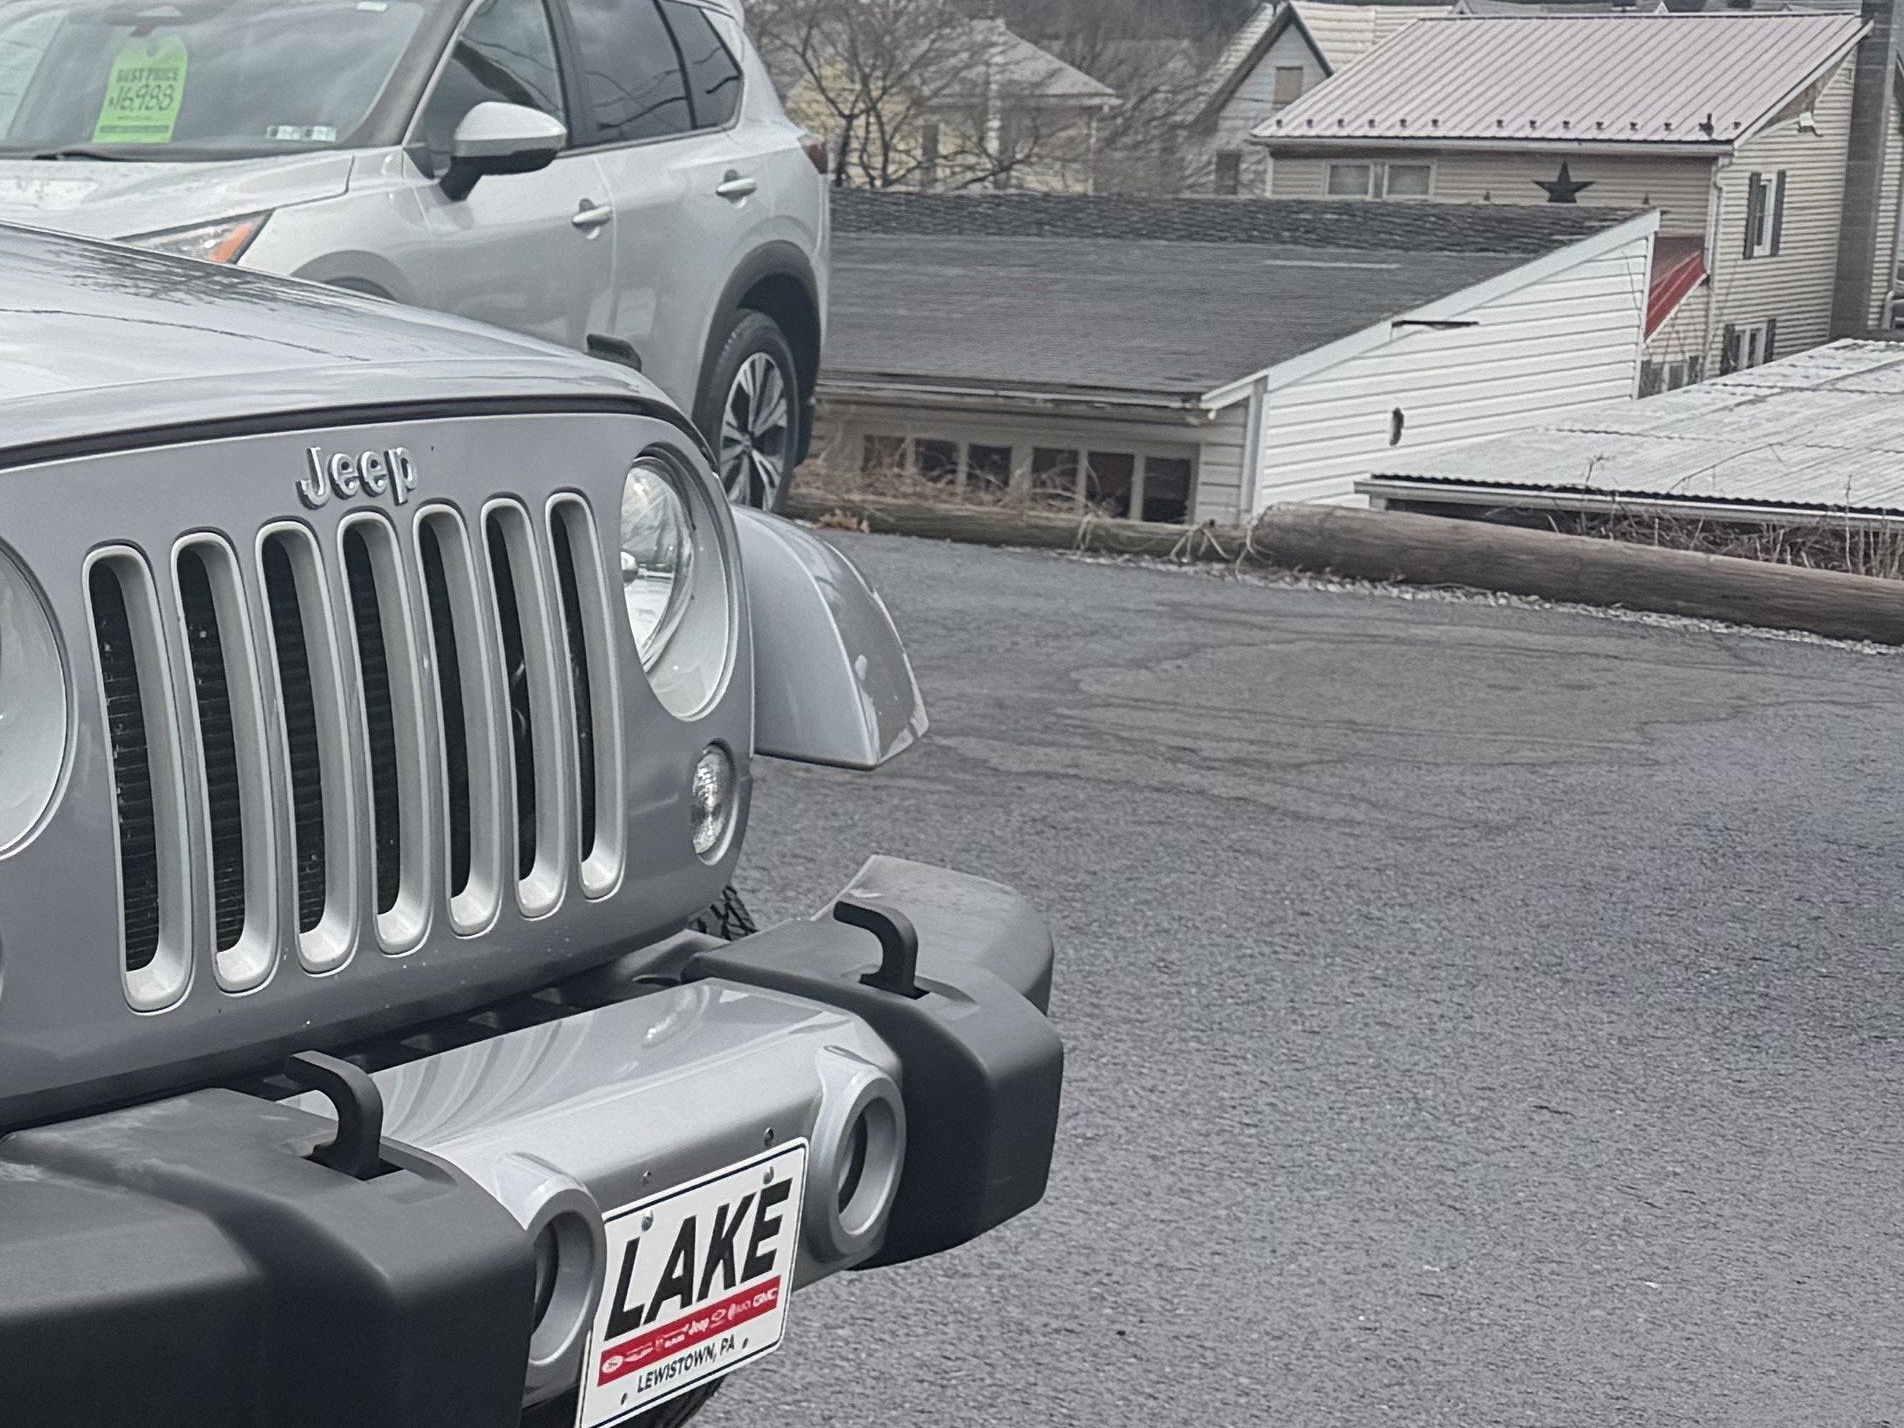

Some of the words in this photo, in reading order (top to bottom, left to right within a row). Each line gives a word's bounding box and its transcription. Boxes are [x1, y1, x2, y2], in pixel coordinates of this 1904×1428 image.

[295, 446, 418, 510] Jeep
[603, 1176, 794, 1342] LAKE
[637, 1341, 718, 1393] LEWISTOWN,
[719, 1334, 736, 1356] PA
